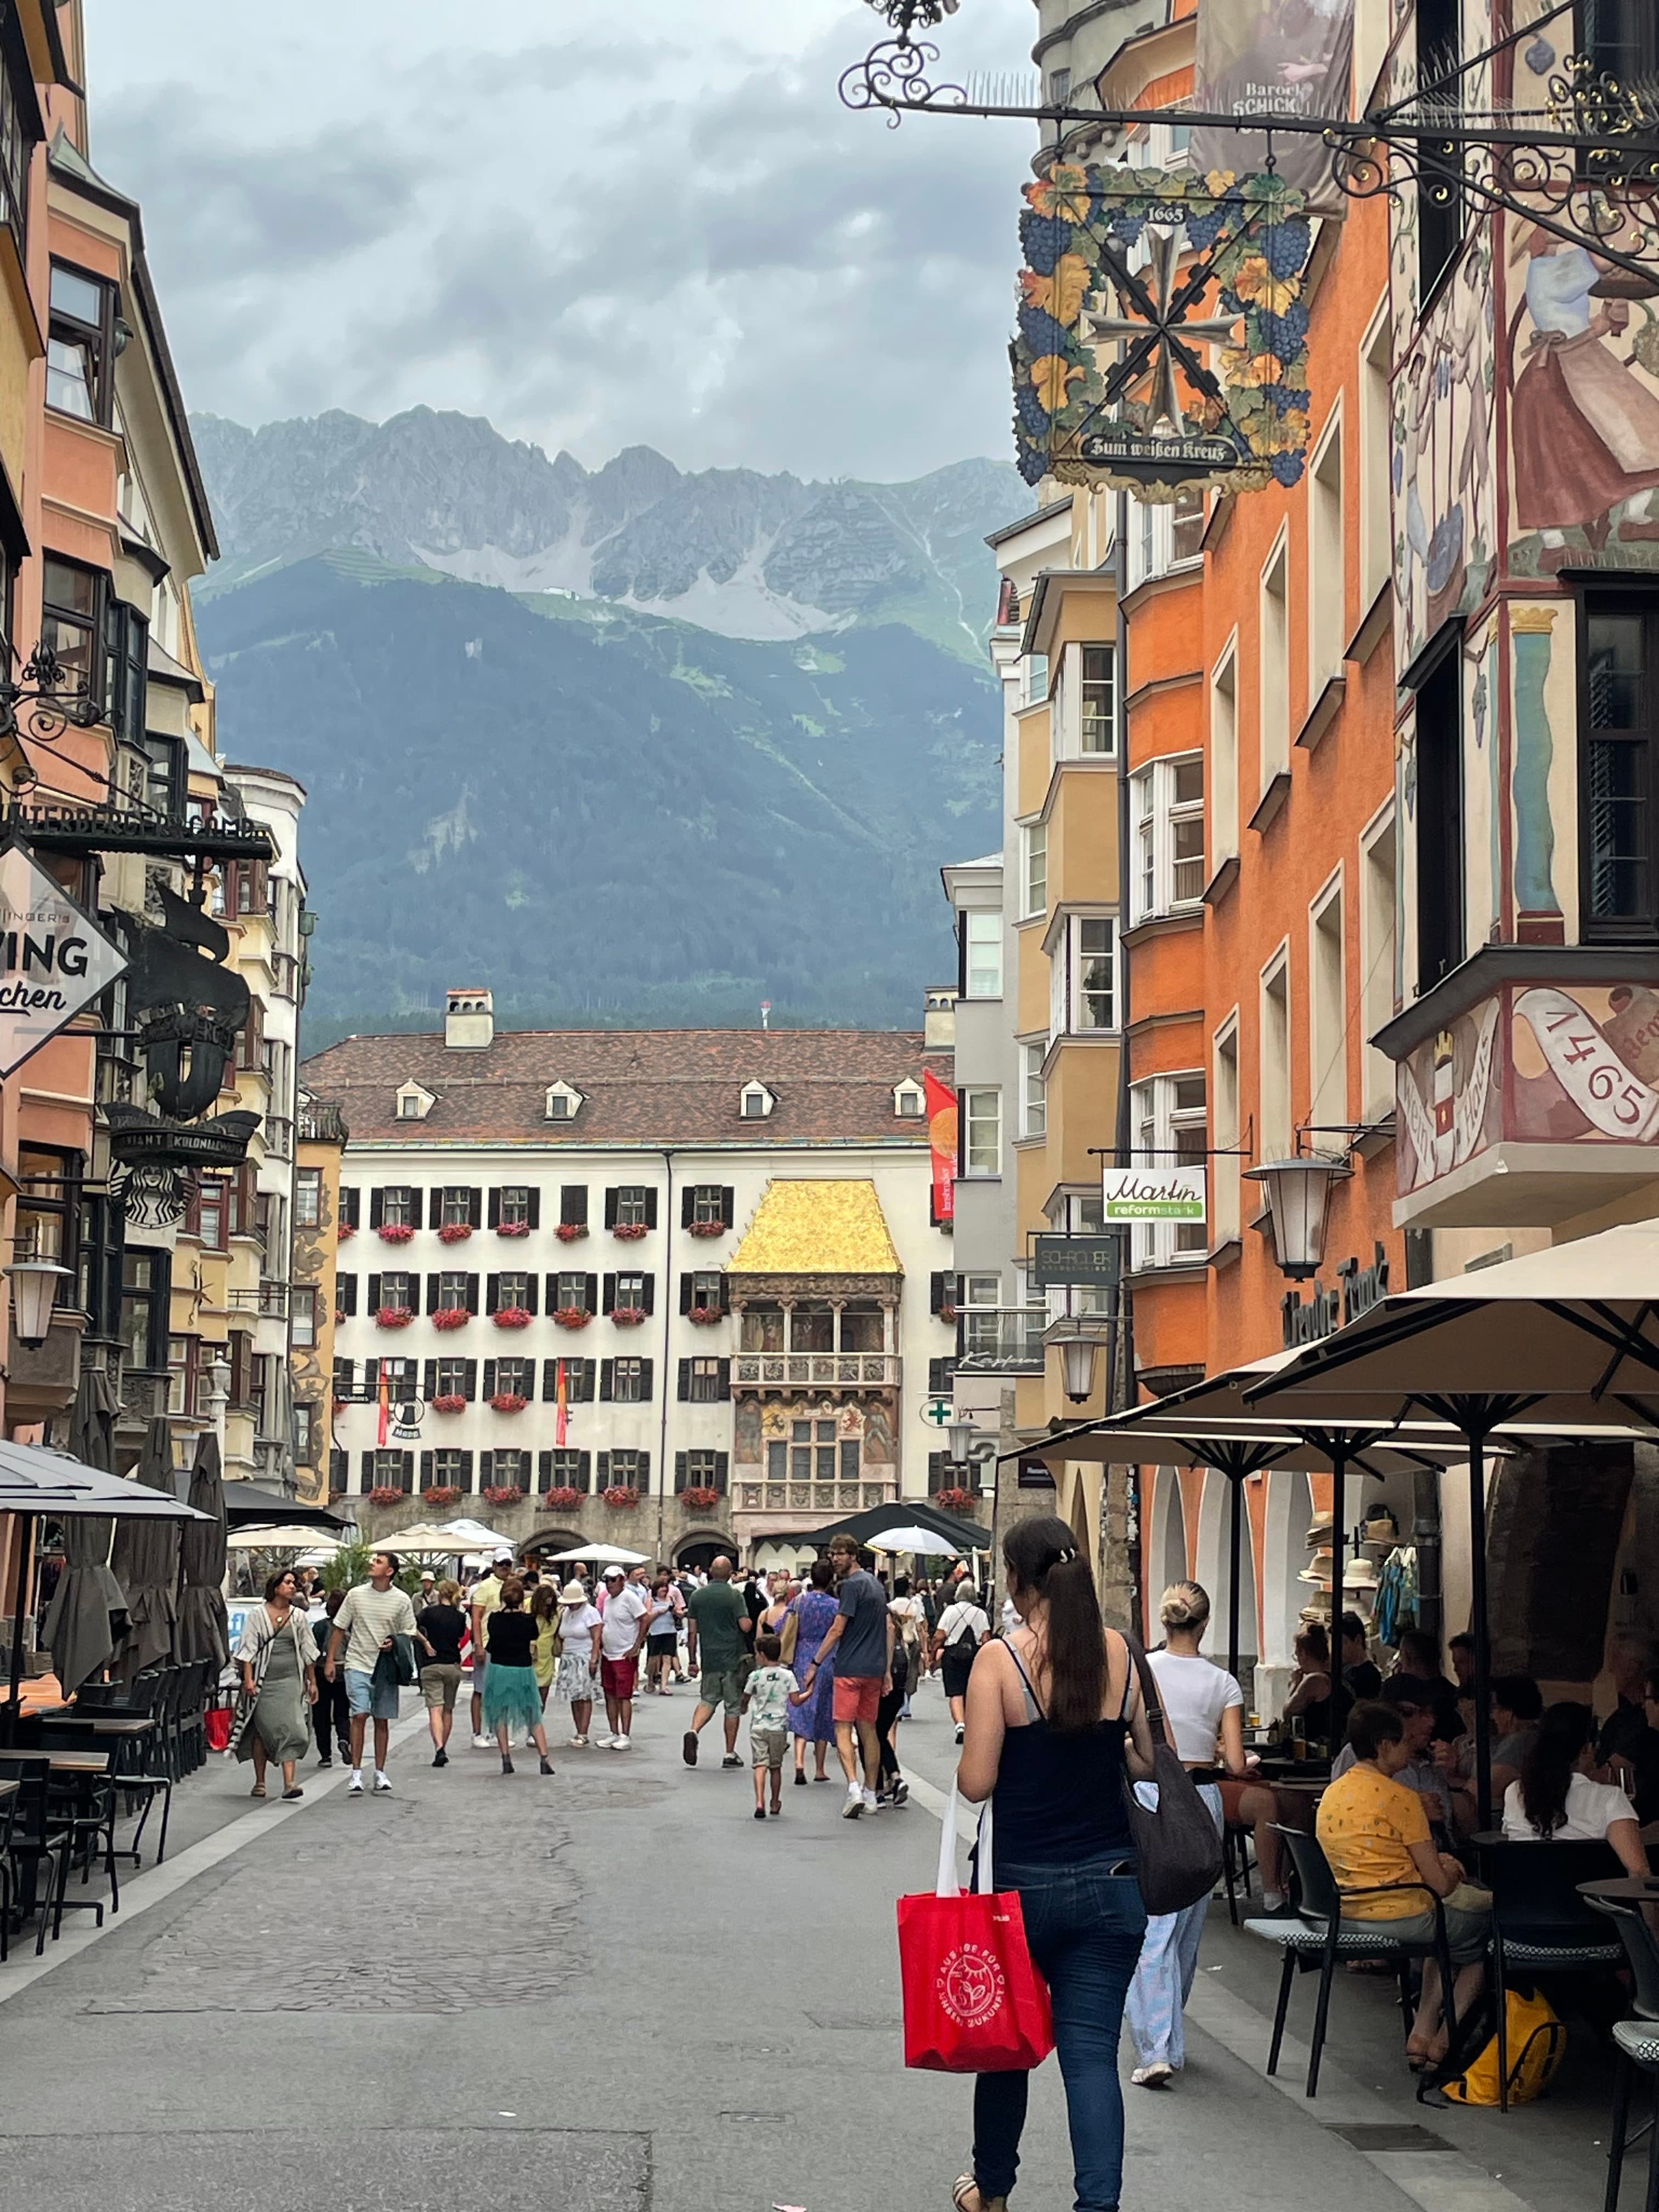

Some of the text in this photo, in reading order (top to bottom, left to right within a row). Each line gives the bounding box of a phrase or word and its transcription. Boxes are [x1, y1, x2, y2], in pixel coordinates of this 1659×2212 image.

[1148, 206, 1183, 223] 1665
[1091, 437, 1226, 461] Zum weißen Kreuz
[1544, 1011, 1646, 1125] 1465
[1107, 1175, 1203, 1201] Martin
[1114, 1204, 1194, 1215] reformstark
